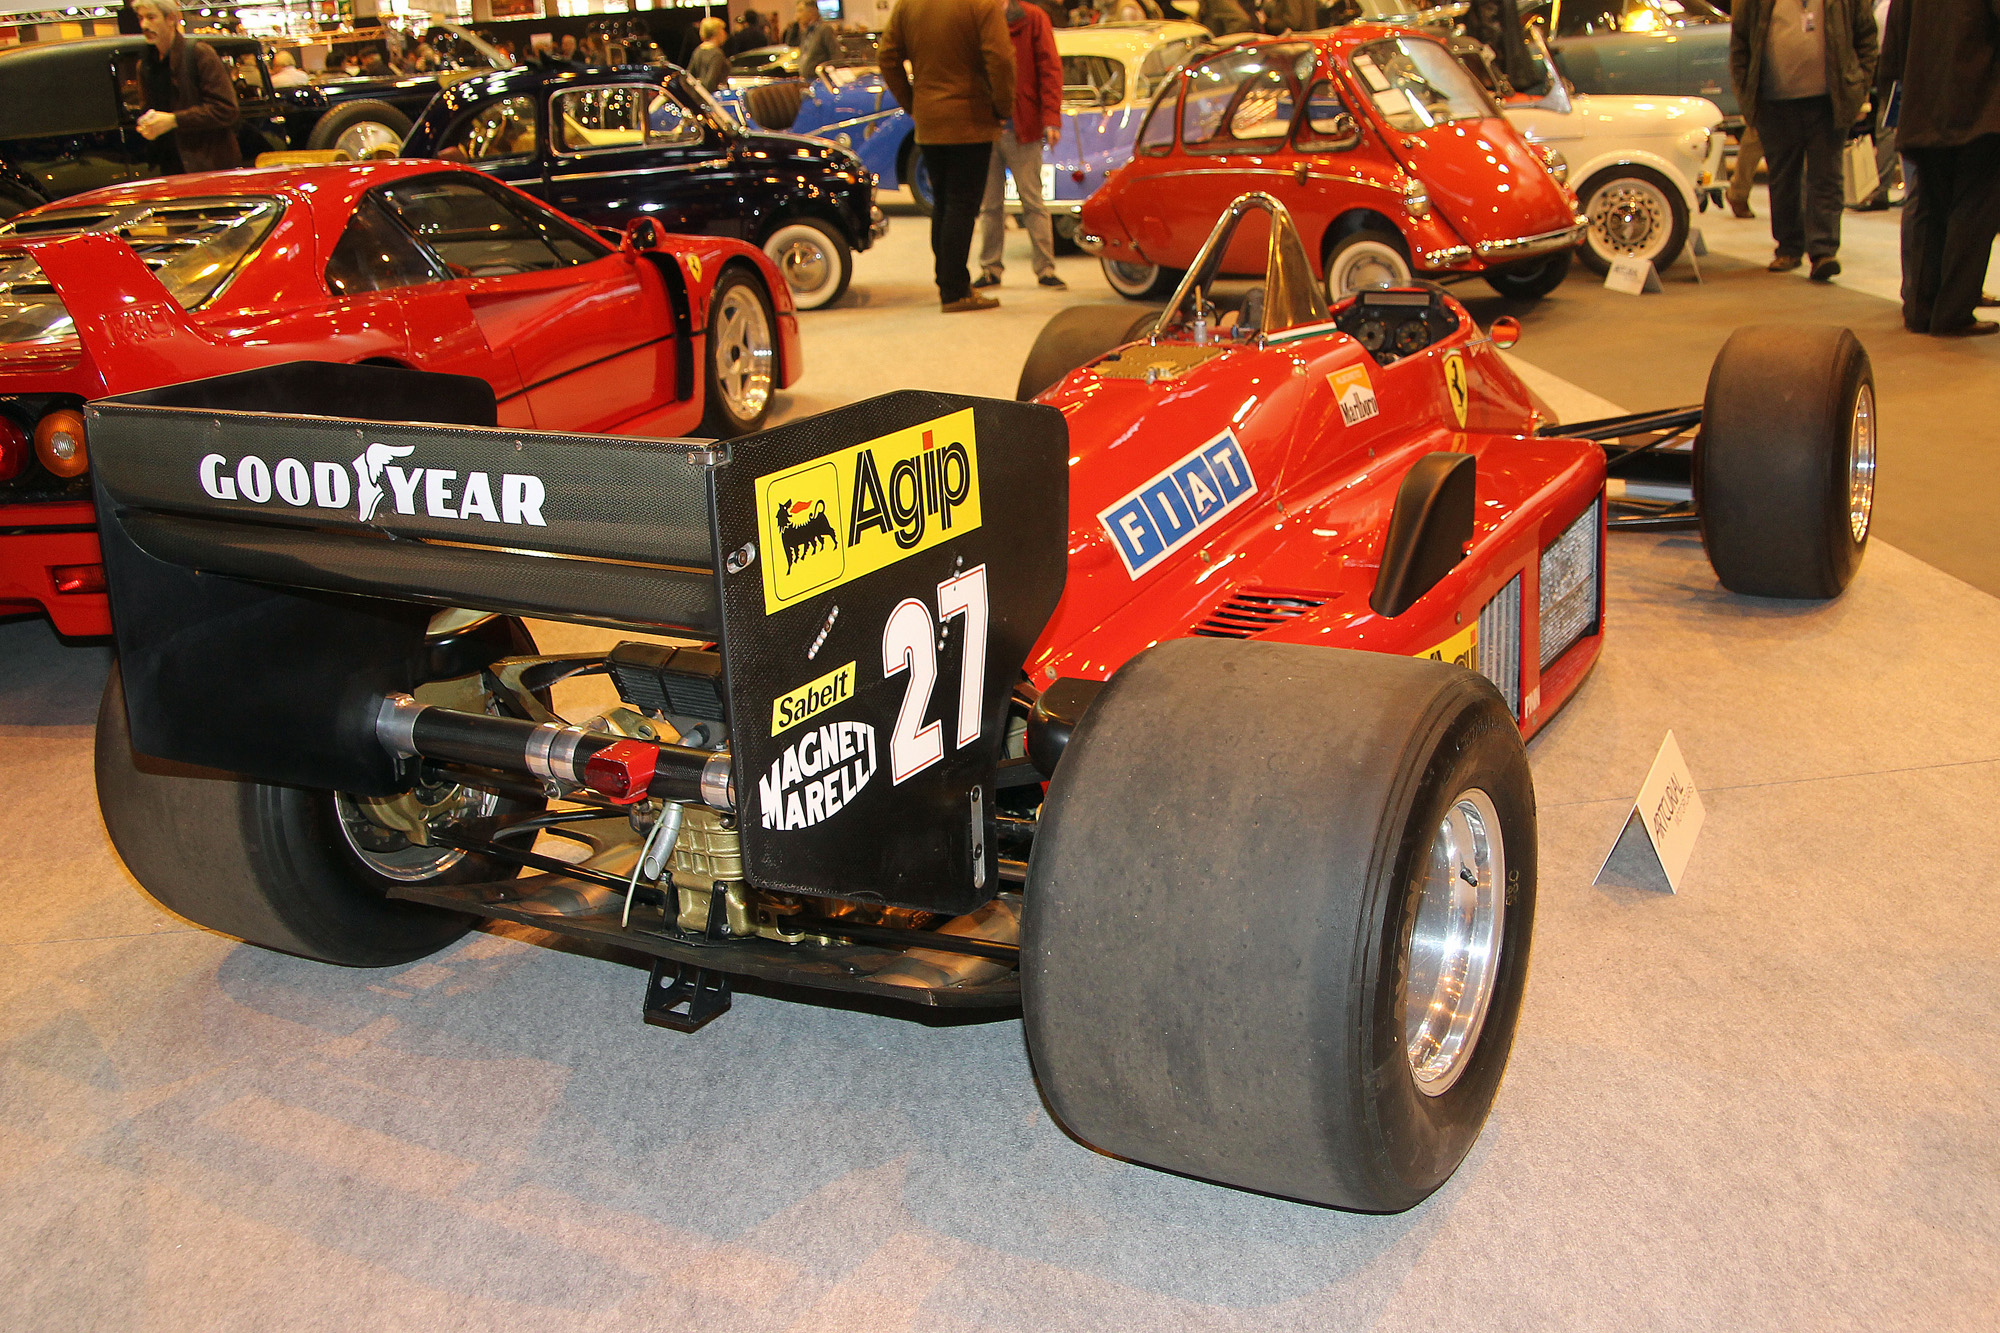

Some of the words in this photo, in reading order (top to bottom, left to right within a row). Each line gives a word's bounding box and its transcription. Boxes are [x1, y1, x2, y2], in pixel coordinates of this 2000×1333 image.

[1340, 392, 1378, 424] Marlboro
[848, 430, 971, 549] Agip
[1118, 447, 1241, 556] FIAT
[778, 669, 849, 728] Sabelt
[882, 563, 989, 787] 27
[758, 721, 877, 797] MAGNETI
